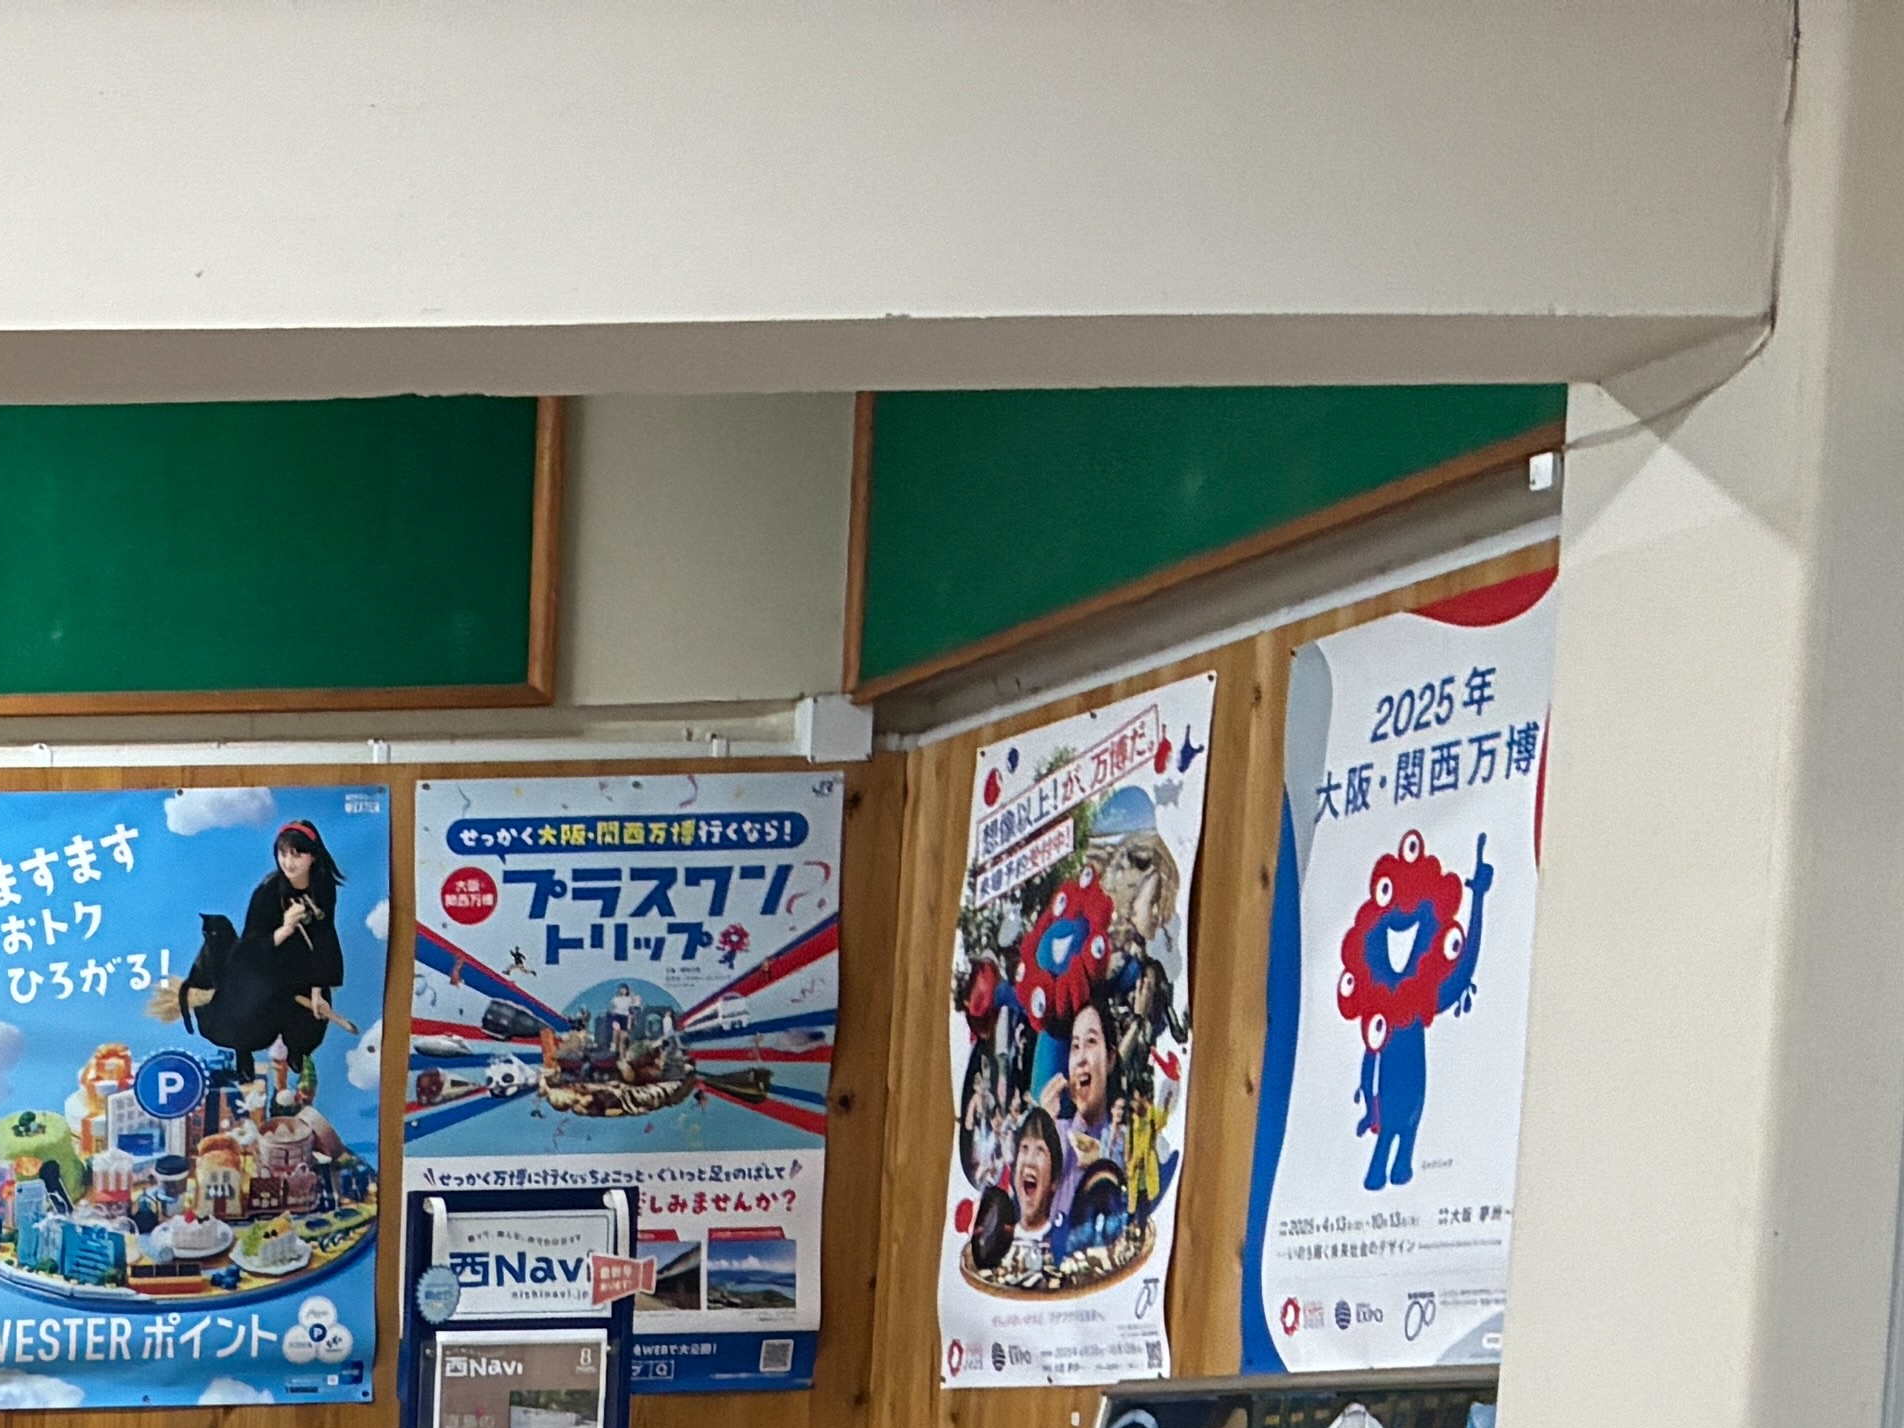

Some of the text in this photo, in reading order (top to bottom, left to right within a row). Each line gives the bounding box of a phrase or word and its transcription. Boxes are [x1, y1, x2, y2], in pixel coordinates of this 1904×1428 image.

[1371, 666, 1496, 743] 2025年
[1315, 720, 1539, 826] 大阪・関西万博
[459, 821, 792, 849] せっかく大阪・関西万博行くなら!
[502, 863, 793, 919] プラスワン
[1, 899, 103, 956] おトク
[545, 921, 713, 966] トリップ
[8, 947, 171, 1004] ひろがる!
[158, 1071, 186, 1104] P
[142, 1313, 278, 1361] ポイント
[580, 1348, 592, 1365] 8
[445, 1356, 524, 1377] 西Navi
